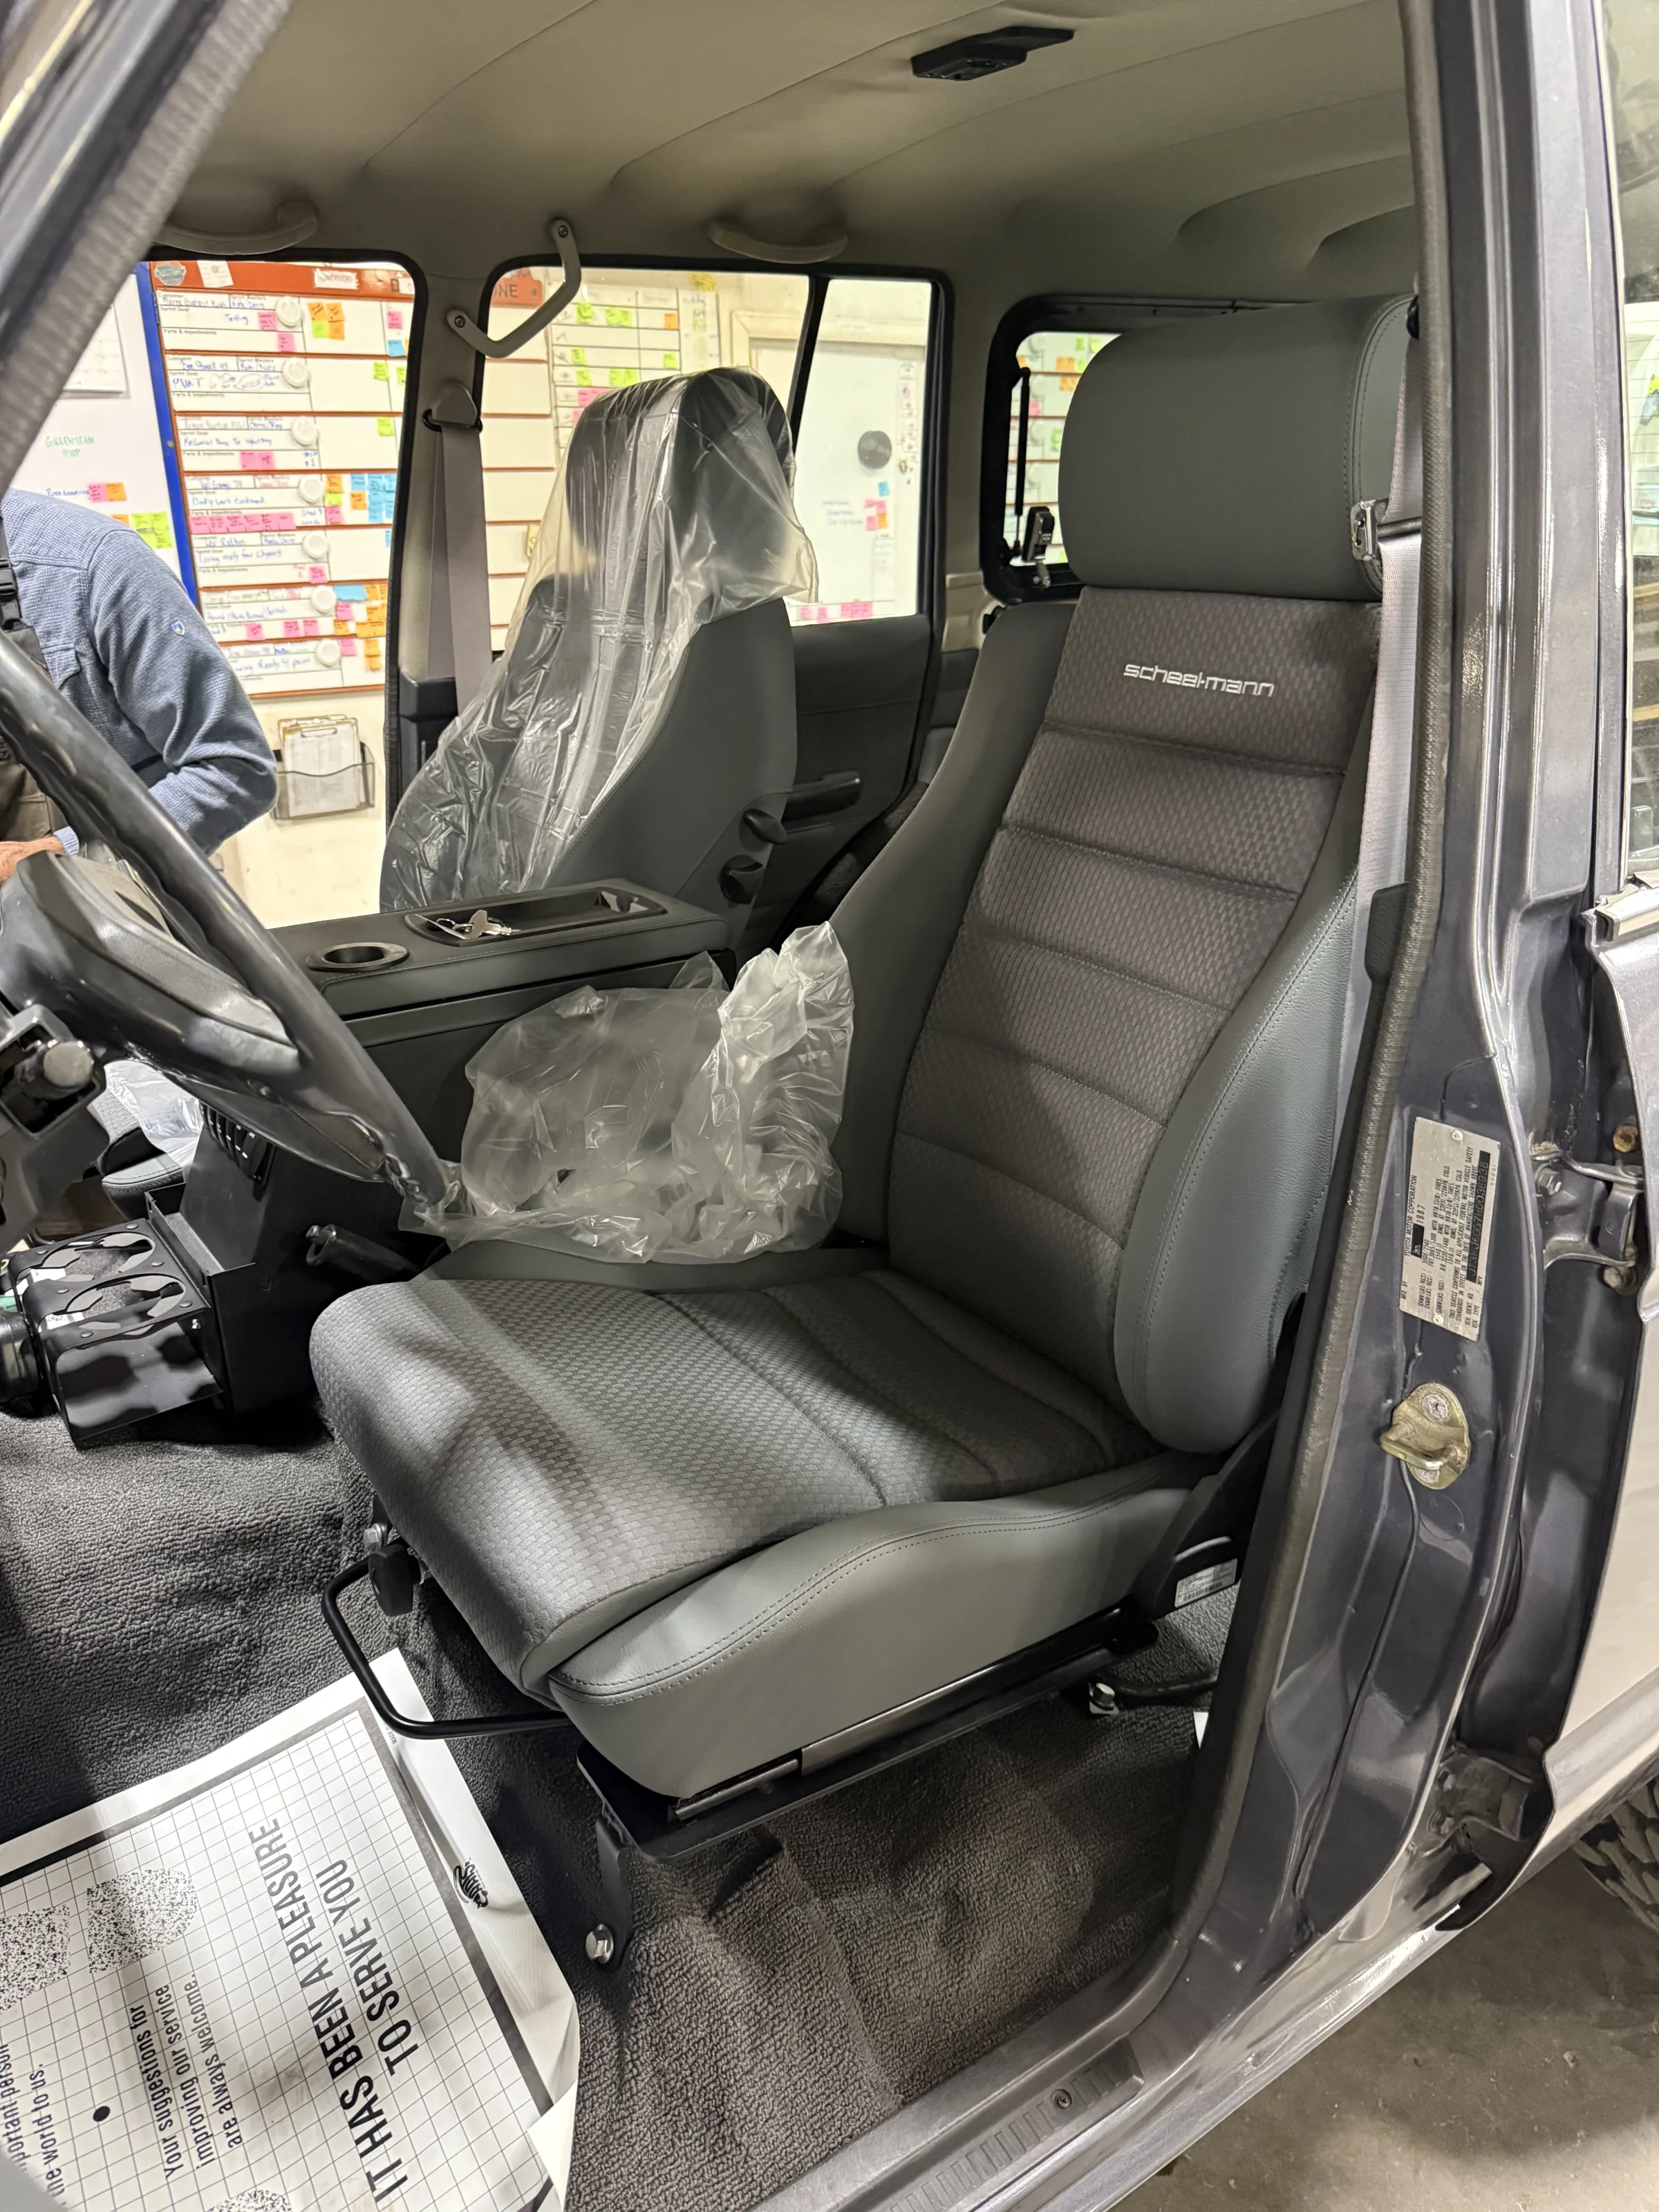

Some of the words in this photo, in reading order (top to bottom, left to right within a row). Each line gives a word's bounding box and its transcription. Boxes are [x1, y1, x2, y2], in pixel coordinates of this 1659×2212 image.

[1416, 1205, 1425, 1224] 1987
[1465, 1201, 1473, 1231] MANUFACTURE
[1452, 1267, 1460, 1289] CONFORMS
[1456, 1223, 1465, 1248] APPLICABLE
[387, 1730, 397, 1744] MADE
[248, 1818, 322, 1965] PLEASURE
[315, 1859, 361, 1927] YOU
[299, 1957, 334, 1990] A
[339, 1916, 401, 2023] SERVE
[129, 2005, 149, 2030] for
[156, 1984, 182, 2045] service
[184, 1974, 216, 2054] welcome.
[308, 1987, 364, 2079] BEEN
[29, 2063, 47, 2091] us.
[171, 2047, 191, 2076] our
[377, 2018, 420, 2077] TO
[31, 2093, 50, 2113] to
[136, 2030, 174, 2132] suggestions
[205, 2053, 234, 2115] always
[3, 2100, 31, 2171] portant
[32, 2114, 60, 2166] world
[180, 2076, 216, 2169] improving
[223, 2117, 243, 2148] are
[341, 2074, 393, 2159] HAS
[162, 2134, 185, 2180] Your
[365, 2157, 409, 2203] IT
